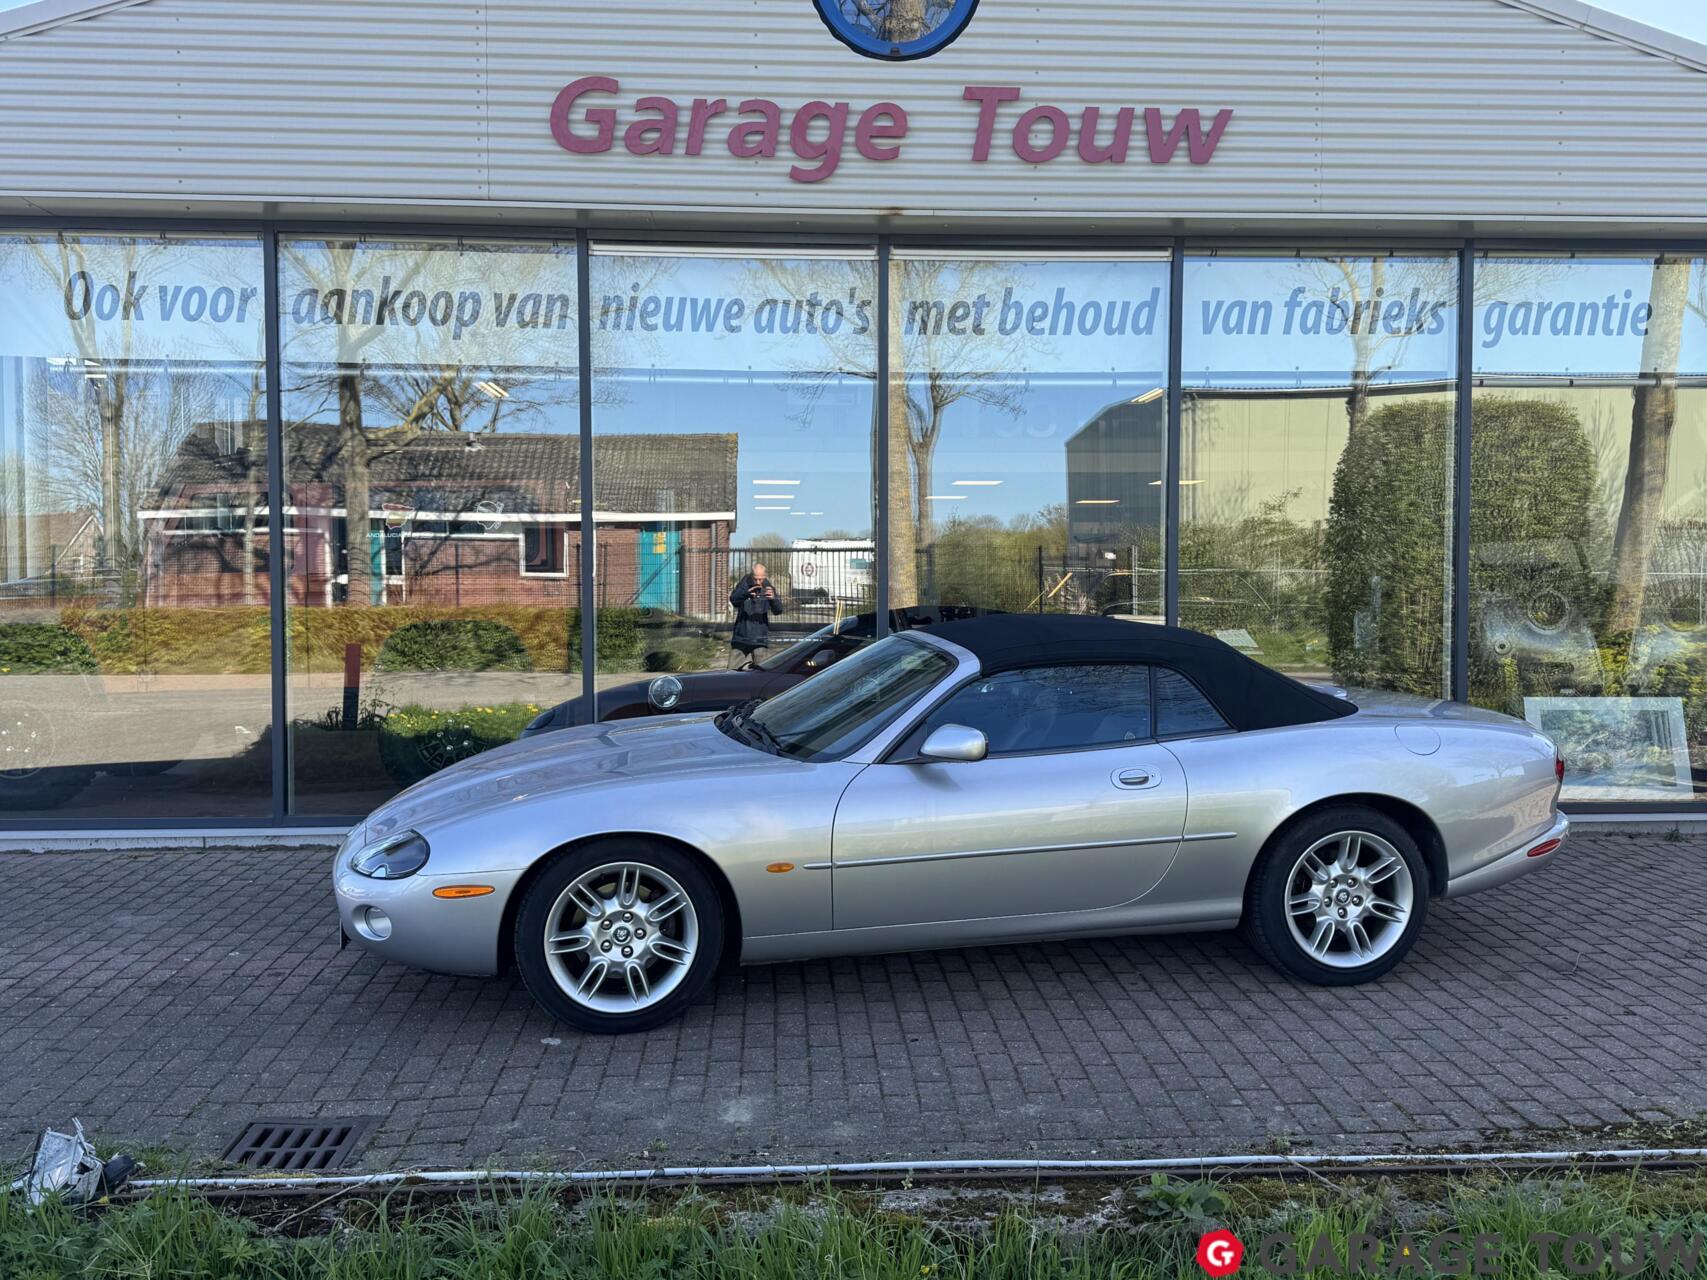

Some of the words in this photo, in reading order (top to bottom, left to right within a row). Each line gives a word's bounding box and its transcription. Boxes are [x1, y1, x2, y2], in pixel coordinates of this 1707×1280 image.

[550, 75, 908, 183] Garage
[962, 86, 1234, 165] Touw
[64, 270, 149, 321] Ook
[158, 285, 257, 323] voor
[291, 275, 482, 341] aankoop
[493, 291, 570, 330] van
[600, 282, 746, 334] nieuwe
[753, 287, 872, 335] auto's
[904, 293, 991, 336] met
[997, 287, 1161, 336] behoud
[1201, 299, 1273, 335] van
[1282, 287, 1445, 336] fabrieks
[1481, 289, 1653, 349] garantie
